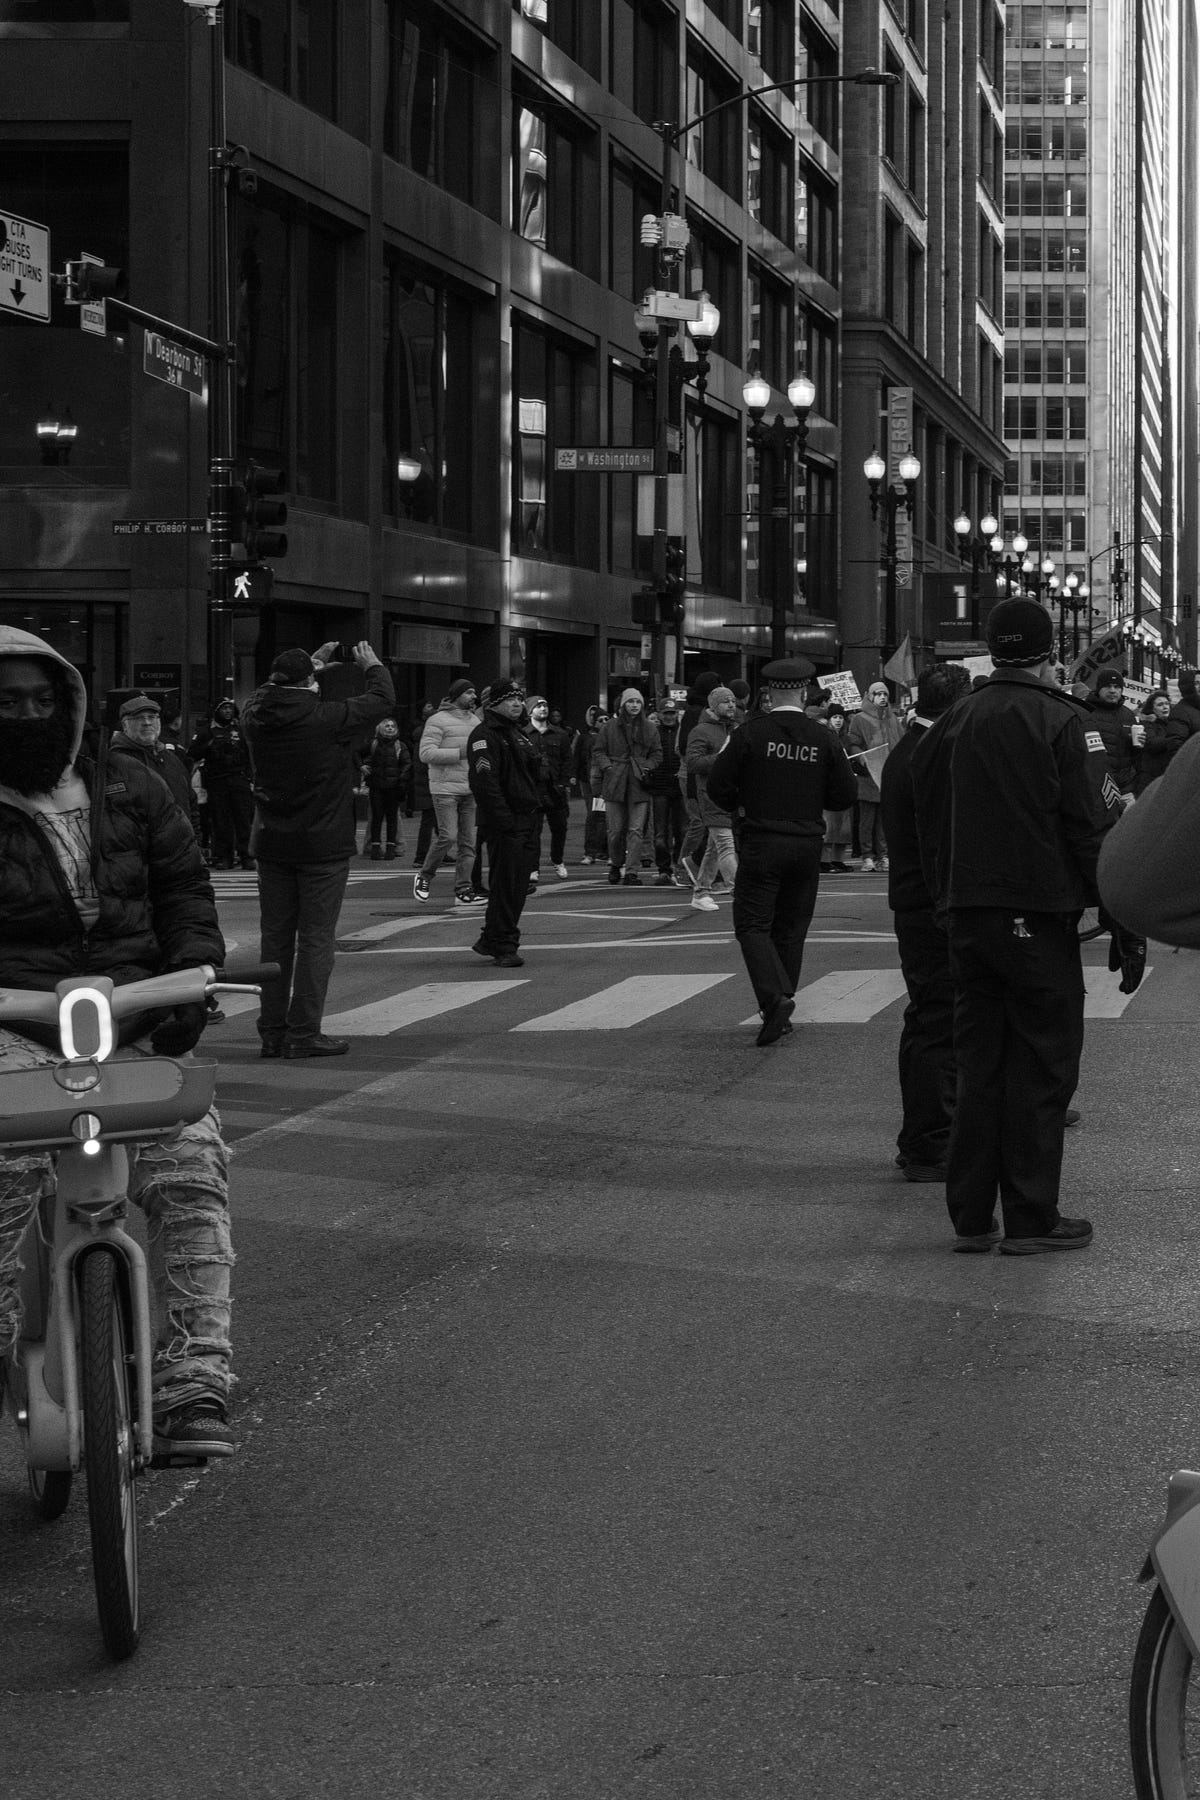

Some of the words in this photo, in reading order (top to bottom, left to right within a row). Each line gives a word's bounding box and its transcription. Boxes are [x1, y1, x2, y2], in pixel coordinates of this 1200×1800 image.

[11, 222, 26, 239] CTA
[6, 239, 31, 259] BUSES
[17, 261, 42, 282] TURNS
[156, 338, 190, 373] Dearborn
[193, 355, 202, 378] St
[587, 451, 640, 469] Washington
[114, 523, 140, 534] PHILIP
[156, 523, 187, 533] CORBOY
[766, 741, 819, 763] POLICE
